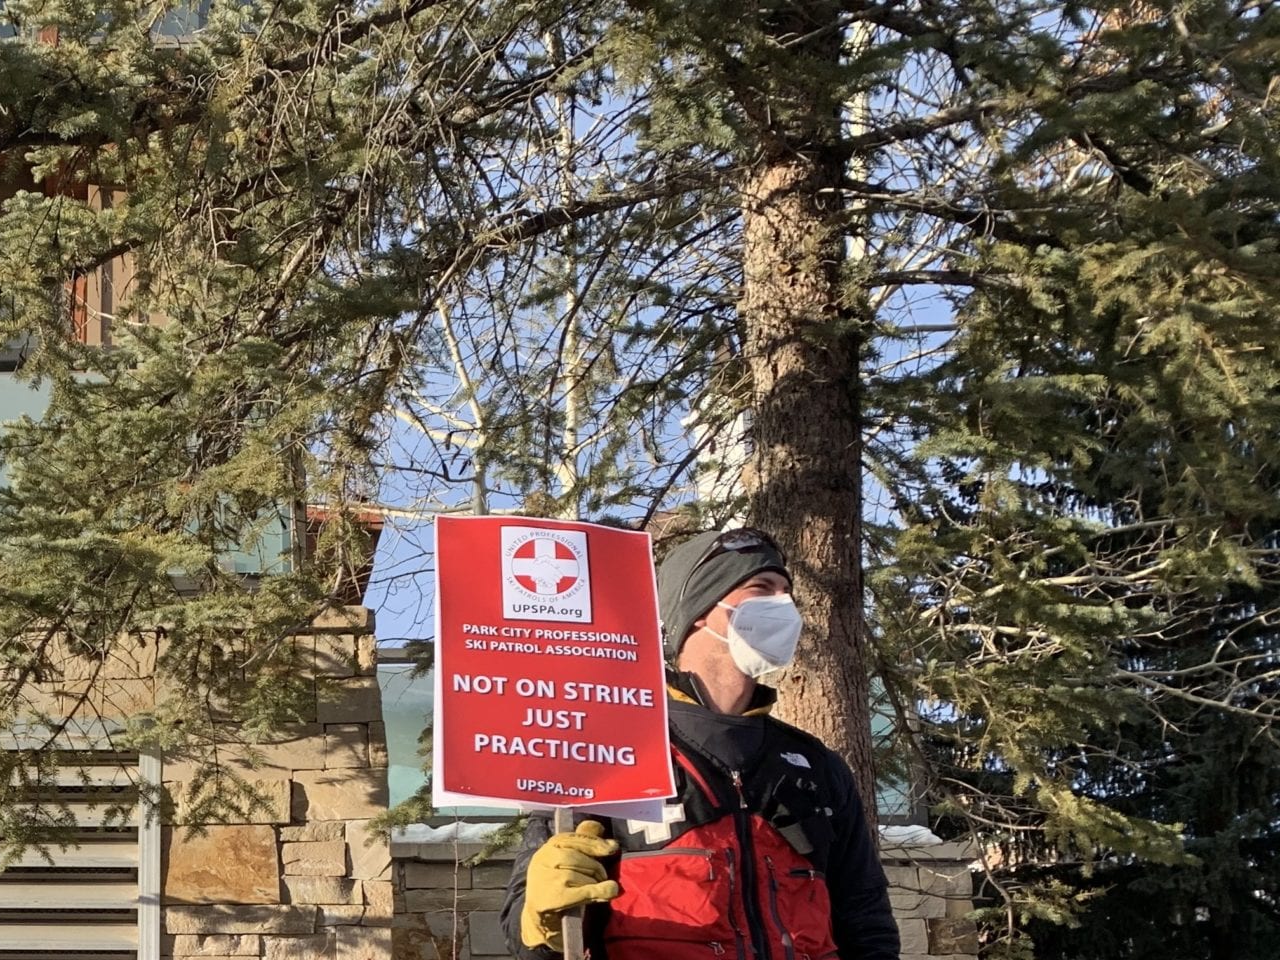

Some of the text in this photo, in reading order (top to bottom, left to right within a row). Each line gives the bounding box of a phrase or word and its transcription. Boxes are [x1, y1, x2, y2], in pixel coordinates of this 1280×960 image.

[505, 531, 584, 558] UNITED PROFESSIONAL
[514, 586, 547, 603] PATROLS
[562, 579, 585, 600] AMERICA
[512, 604, 582, 618] UPSPA.org
[463, 624, 637, 644] PARK CITY PROFESSIONAL
[466, 640, 636, 660] SKI PATROL ASSOCIATION
[454, 674, 653, 706] NOT ON STRIKE
[522, 709, 586, 729] JUST
[475, 734, 634, 765] PRACTICING
[517, 779, 593, 798] UPSPA.org
